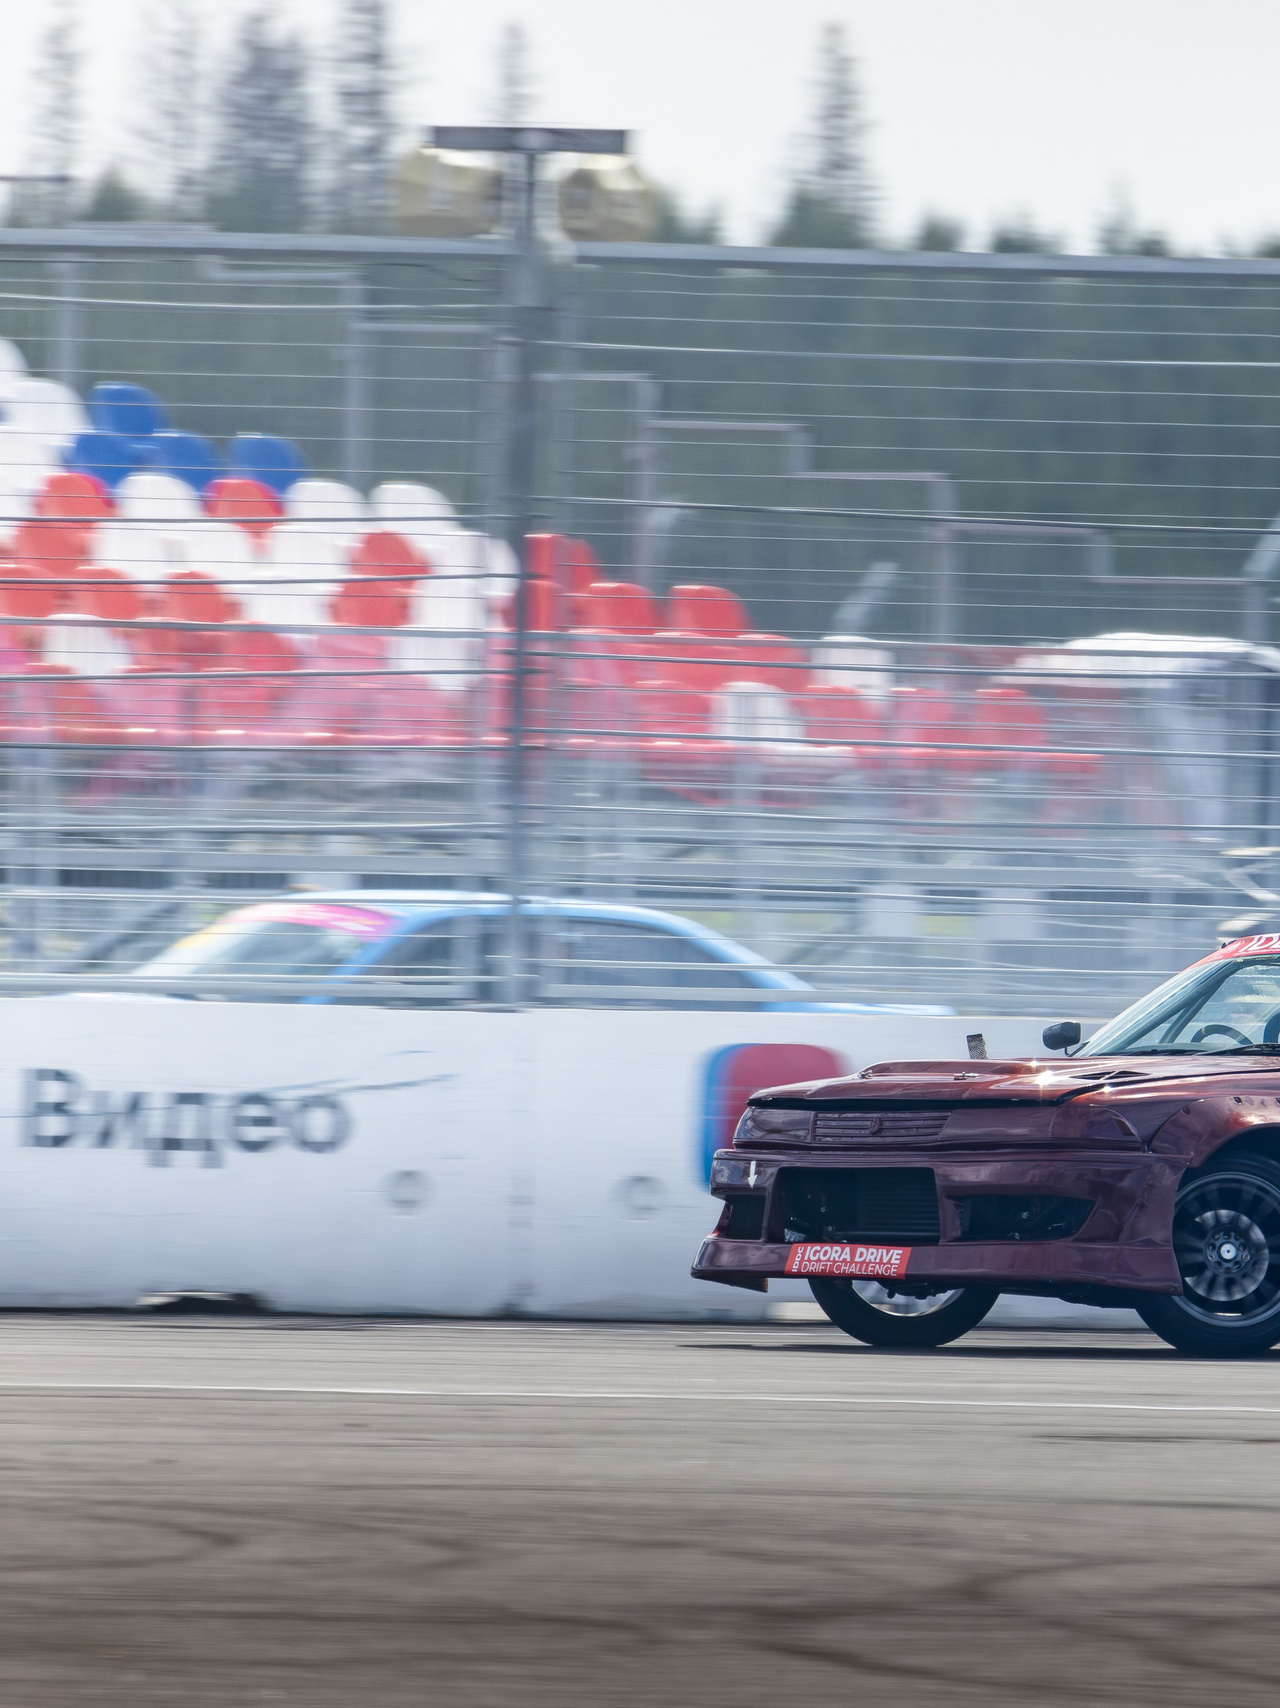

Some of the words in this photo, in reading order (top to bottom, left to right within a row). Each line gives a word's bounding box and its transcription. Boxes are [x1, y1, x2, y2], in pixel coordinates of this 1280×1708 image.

[20, 1067, 353, 1168] Видео
[792, 1246, 805, 1272] IDDC
[804, 1246, 851, 1262] IGORA
[854, 1247, 903, 1264] DRIVE
[801, 1261, 833, 1273] DRIFT
[833, 1262, 899, 1276] CHALLENGE
